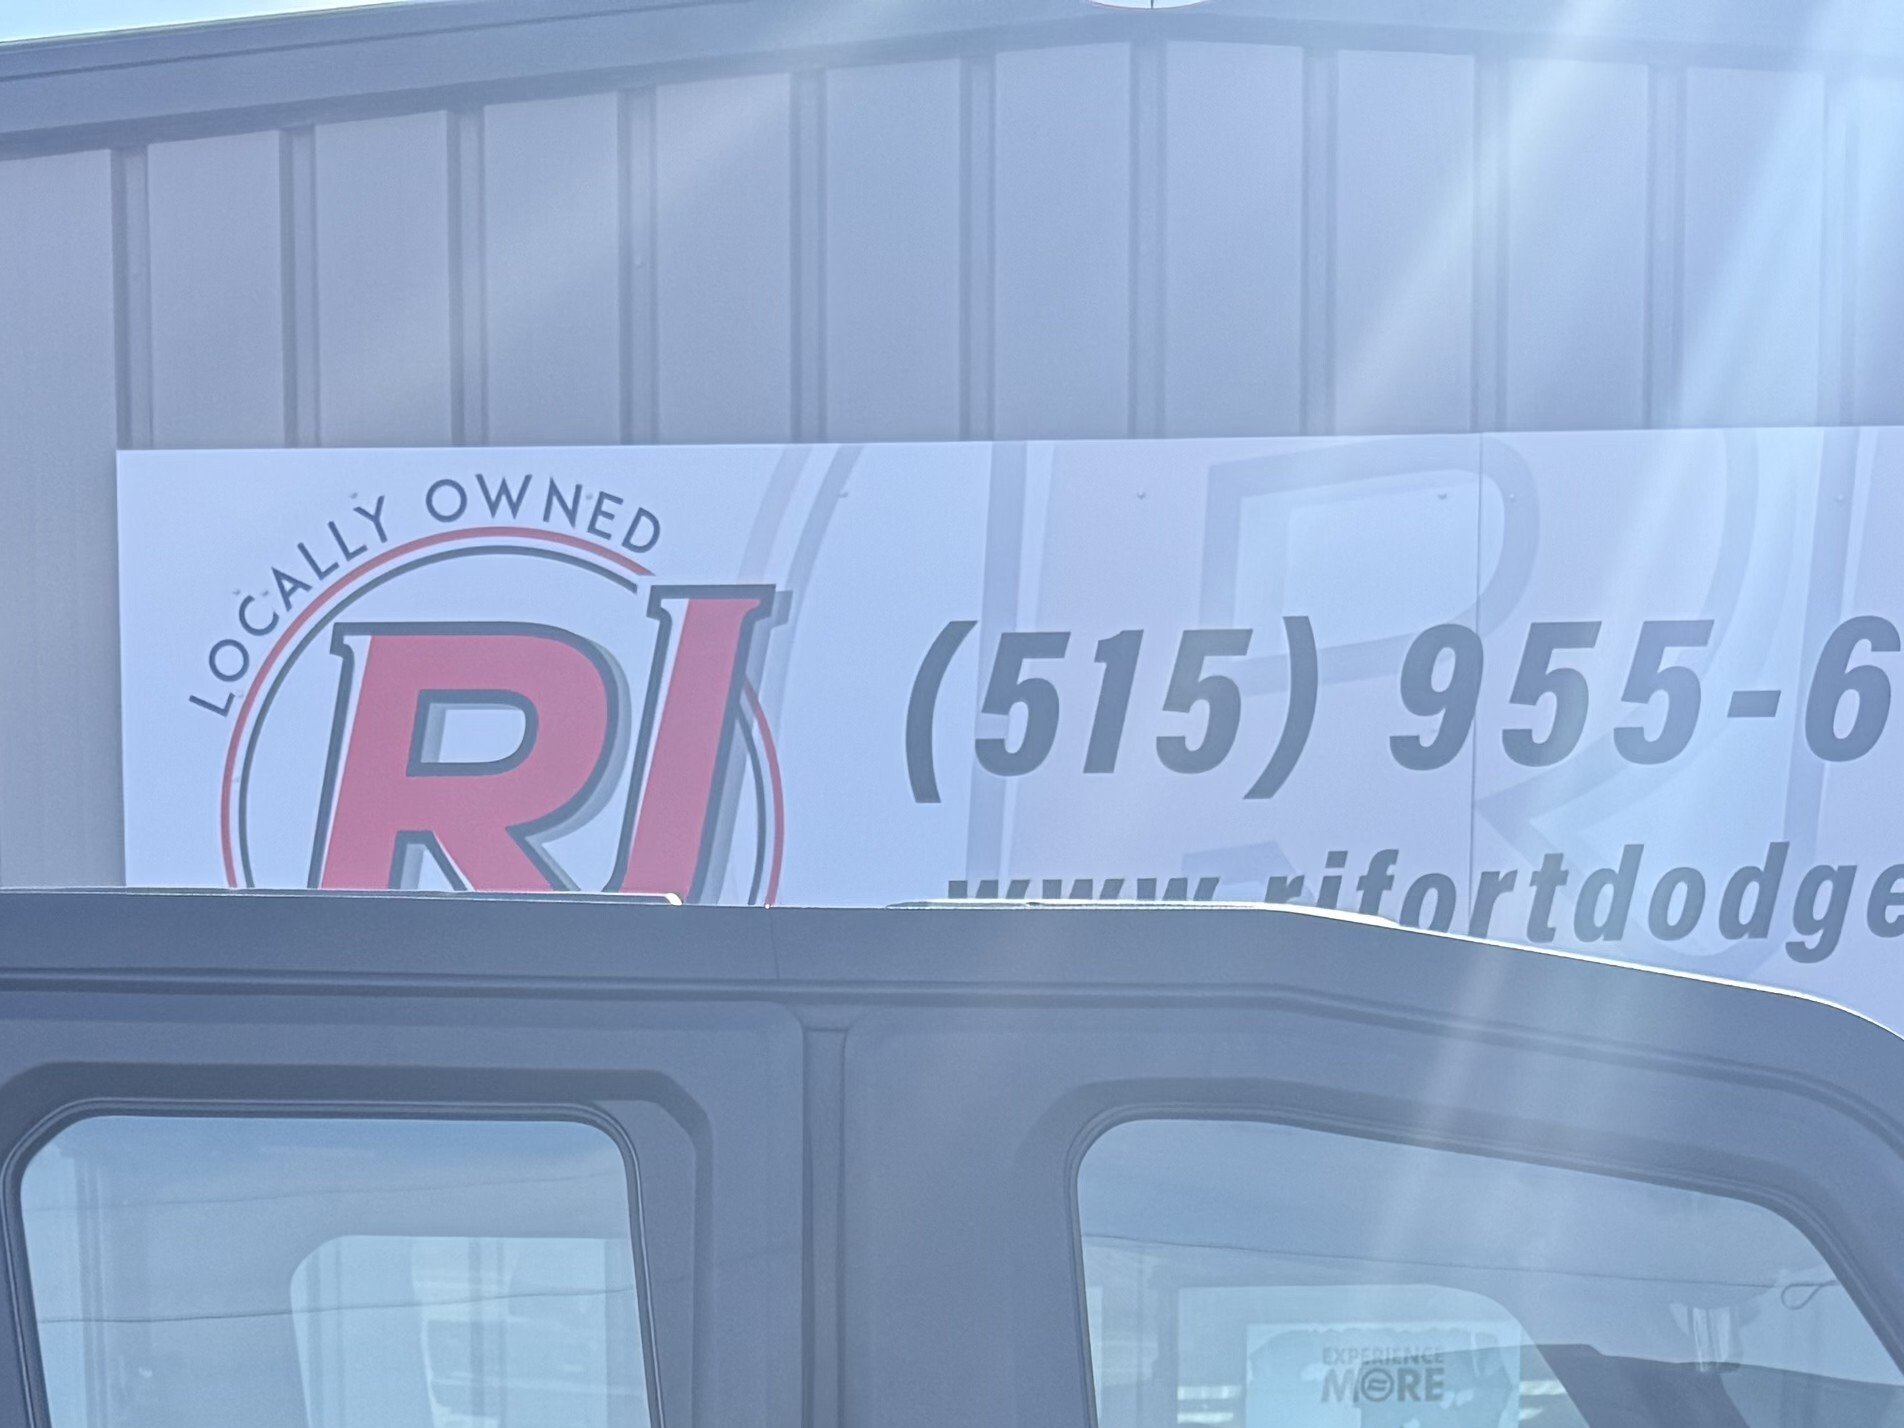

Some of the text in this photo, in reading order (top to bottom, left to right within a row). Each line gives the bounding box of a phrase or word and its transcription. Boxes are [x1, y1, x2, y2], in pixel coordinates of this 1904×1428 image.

[188, 473, 662, 718] LOCALLY OWNED
[905, 615, 1319, 803] (515)
